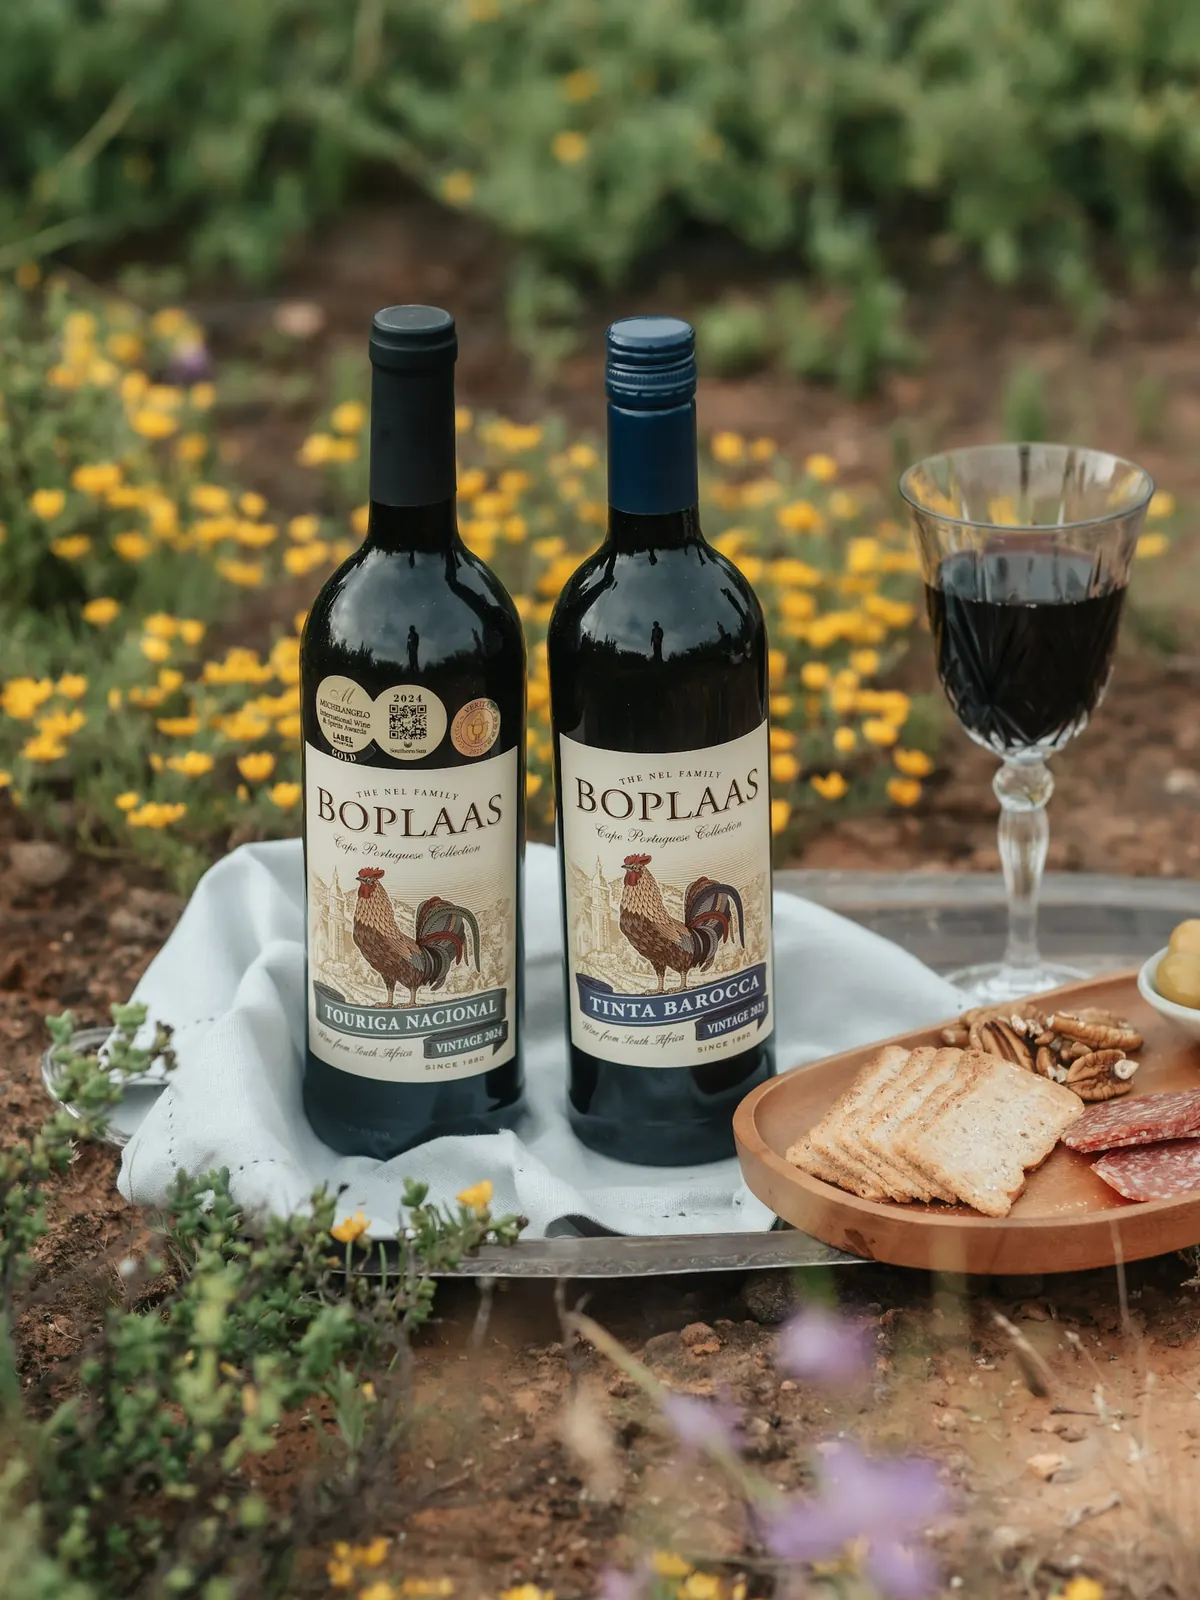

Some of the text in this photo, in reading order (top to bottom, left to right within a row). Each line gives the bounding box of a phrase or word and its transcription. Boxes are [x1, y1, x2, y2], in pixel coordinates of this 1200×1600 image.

[320, 699, 370, 719] MICHELANGELO
[393, 694, 422, 703] 2024
[320, 709, 371, 729] International Wine
[328, 719, 343, 729] Spirits
[344, 725, 367, 735] Awards
[332, 732, 353, 744] LABEL
[331, 748, 356, 762] GOLD
[619, 770, 722, 785] THE NEL FAMILY
[356, 788, 461, 801] THE NEL FAMILY
[575, 768, 758, 822] BOPLAAS
[317, 785, 502, 838] BOPLAAS
[595, 821, 742, 848] Cape Portuguese Collection
[333, 833, 481, 864] Cape Portuguese Collection
[590, 975, 760, 1018] TINTA BAROCCA
[325, 1000, 497, 1030] TOURIGA NACIONAL
[707, 1011, 749, 1034] VINTAGE
[317, 1028, 413, 1061] Wine from South Africa
[436, 1027, 503, 1053] VINTAGE 2024
[582, 1020, 684, 1048] Wine from South Africa
[697, 1032, 751, 1053] SINCE 1880
[425, 1056, 485, 1070] SINCE 1880
